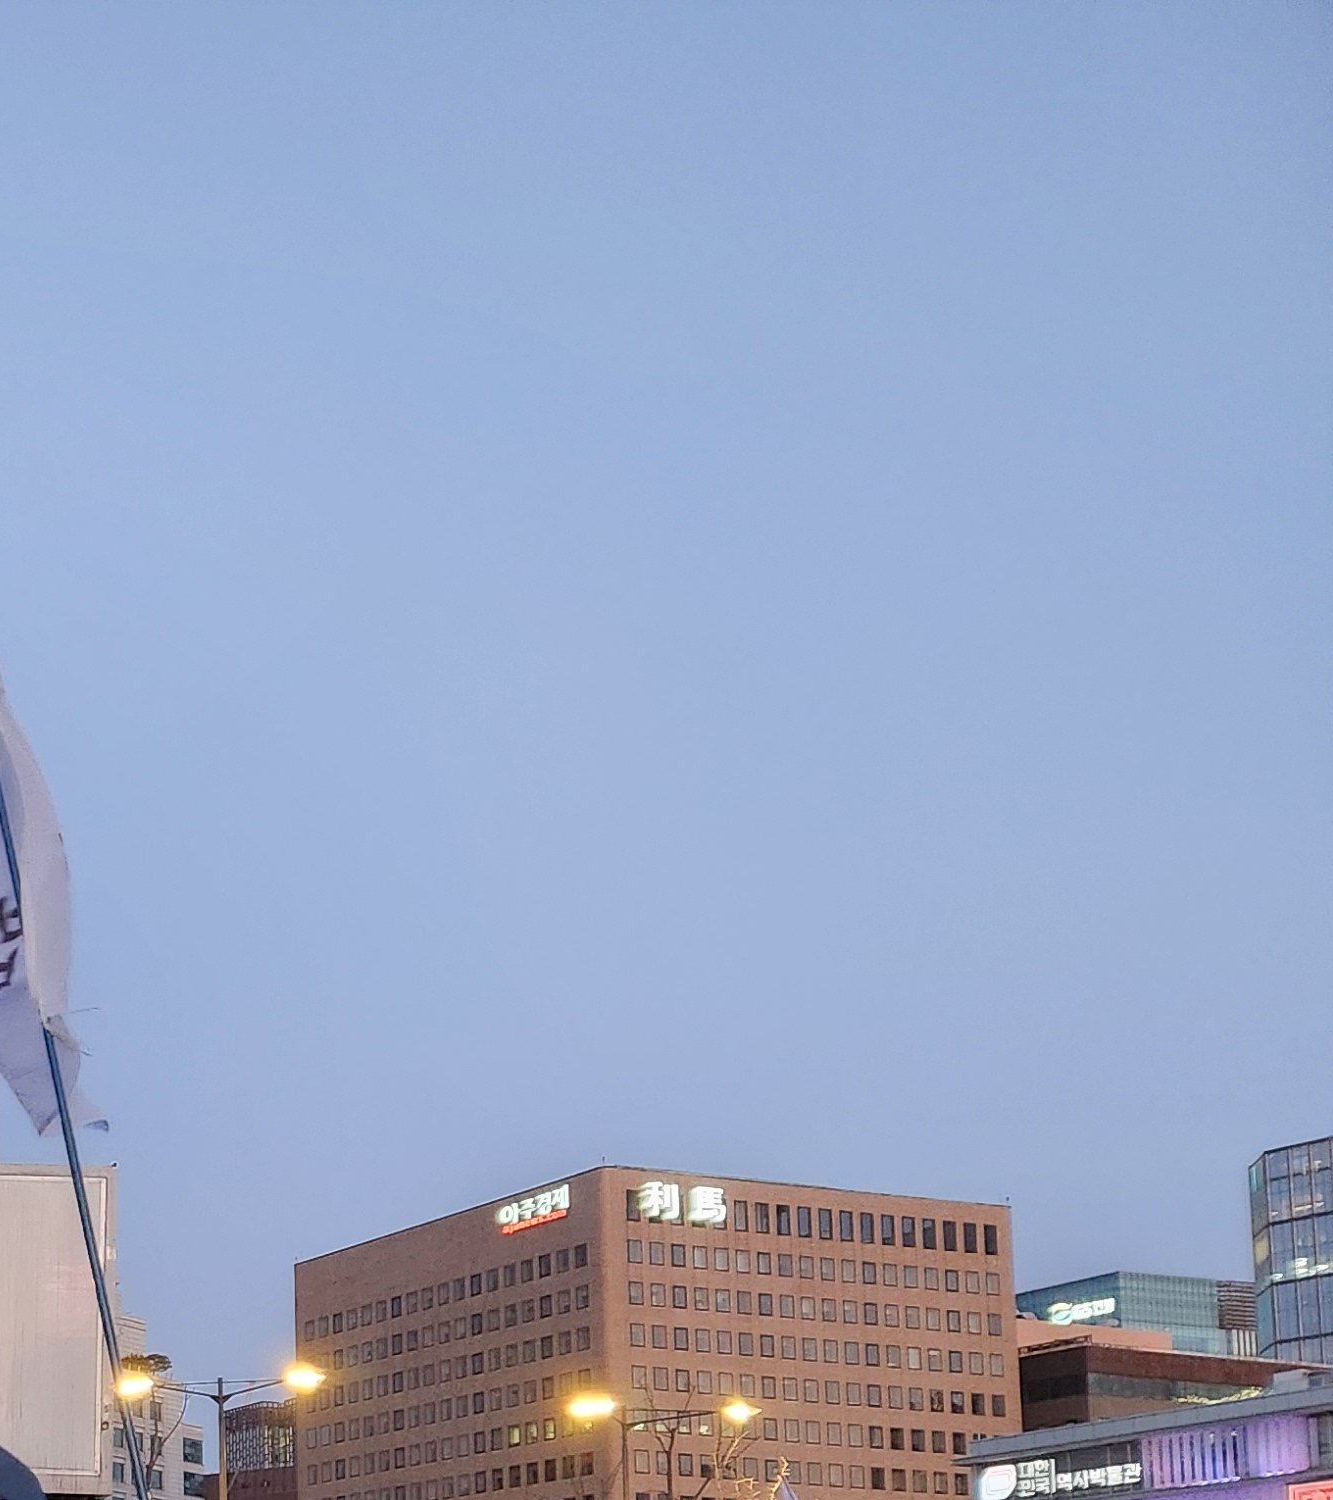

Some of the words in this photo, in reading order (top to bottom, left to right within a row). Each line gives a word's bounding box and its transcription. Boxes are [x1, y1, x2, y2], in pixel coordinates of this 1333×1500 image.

[498, 1184, 570, 1225] 아주경제
[639, 1181, 727, 1224] 利馬
[1056, 1462, 1143, 1492] 역사박물관
